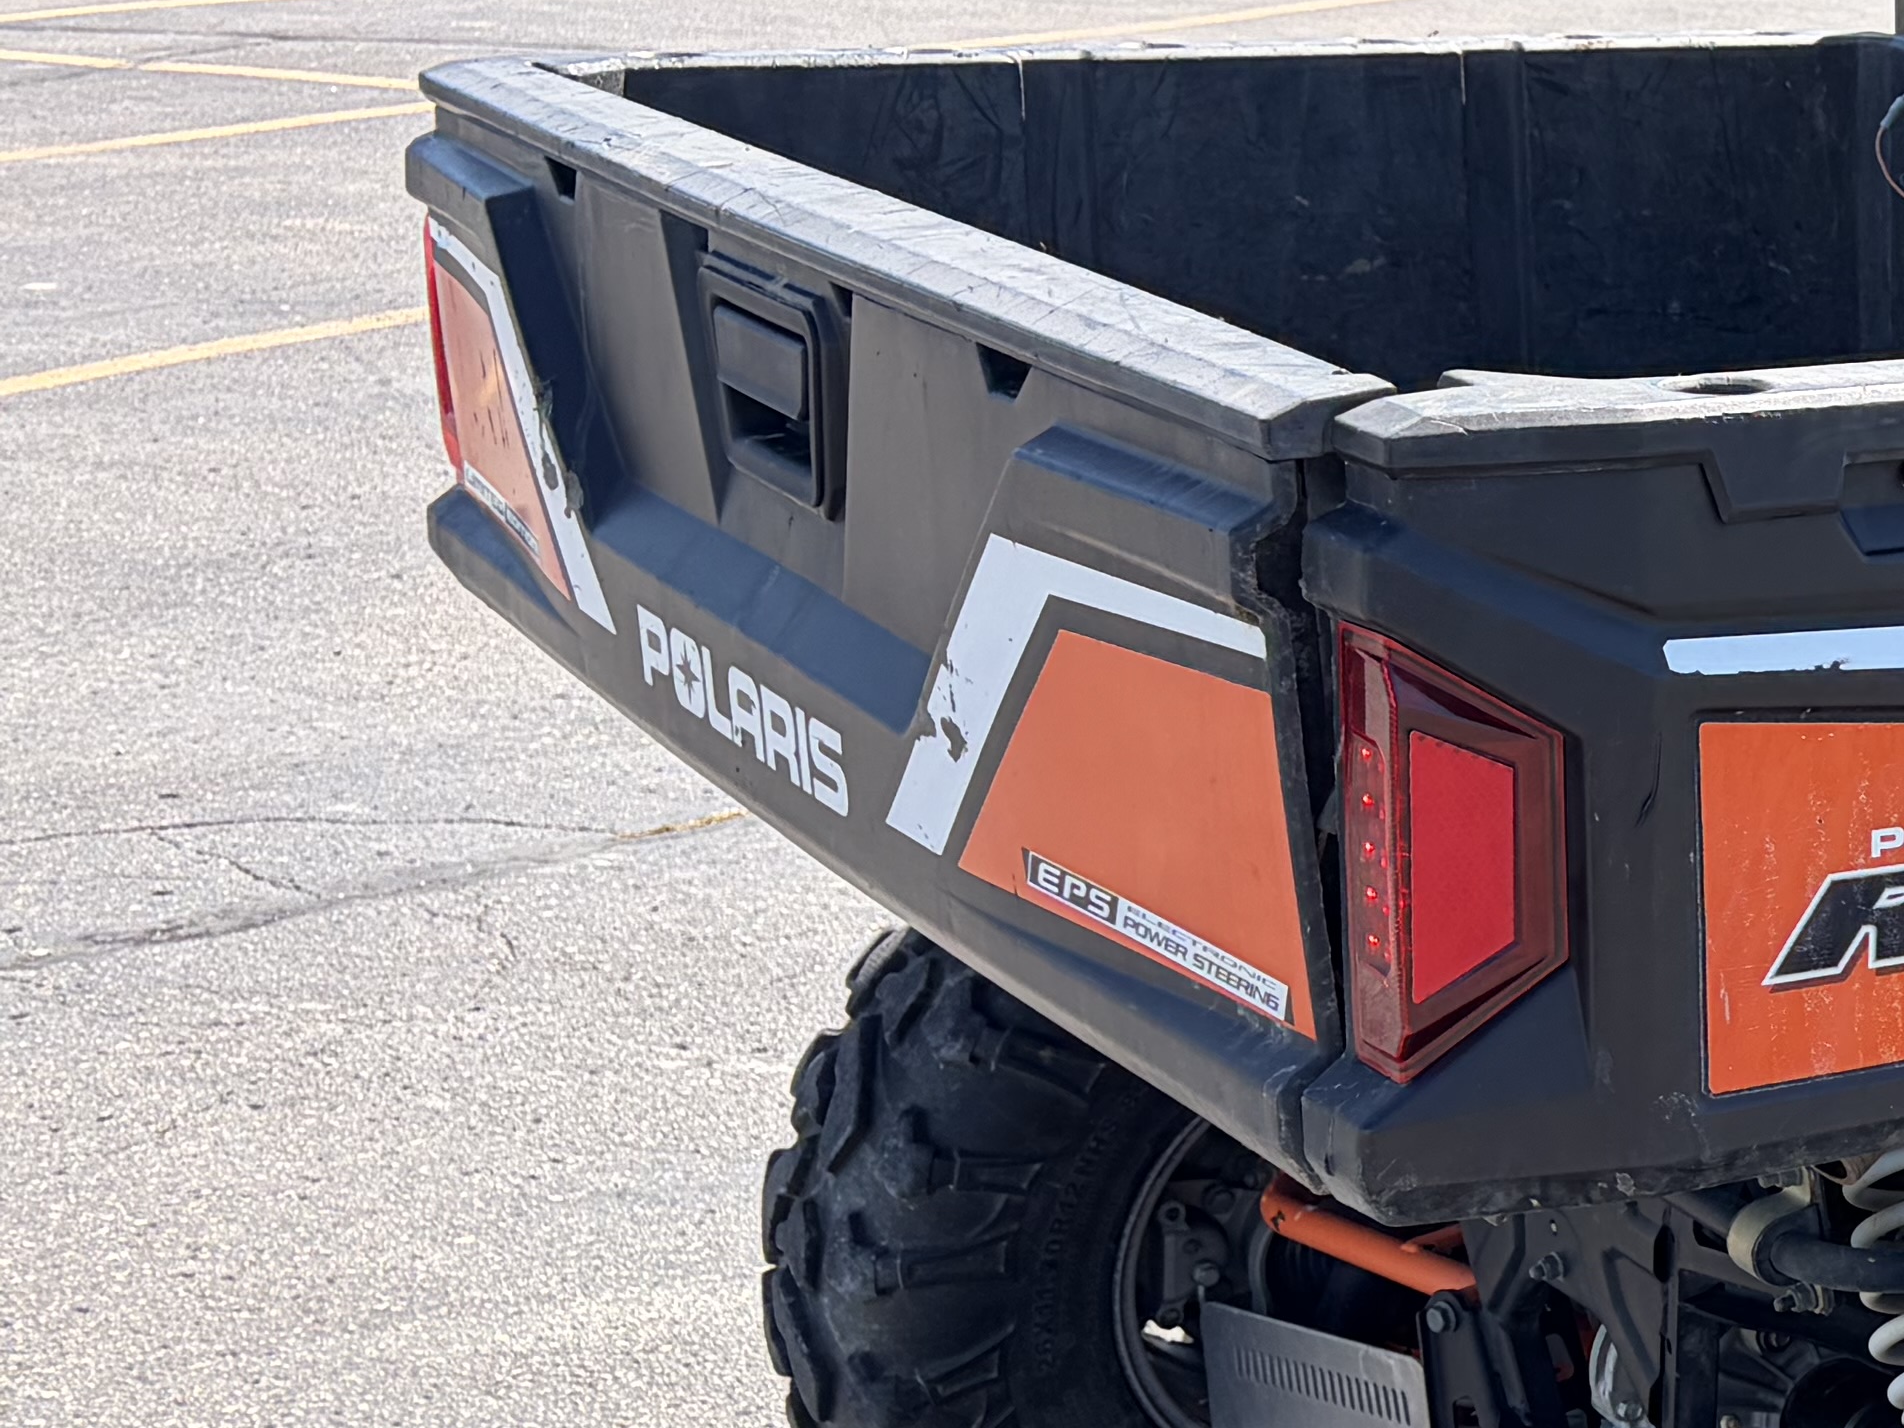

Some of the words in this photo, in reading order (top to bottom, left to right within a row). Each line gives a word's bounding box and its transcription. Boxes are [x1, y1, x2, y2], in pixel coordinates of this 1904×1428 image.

[637, 603, 849, 818] POLARIS
[1036, 861, 1112, 920] EPS
[1122, 914, 1188, 962] POWER
[1192, 952, 1280, 1012] STEERING
[1126, 904, 1278, 992] ELECTRONIC
